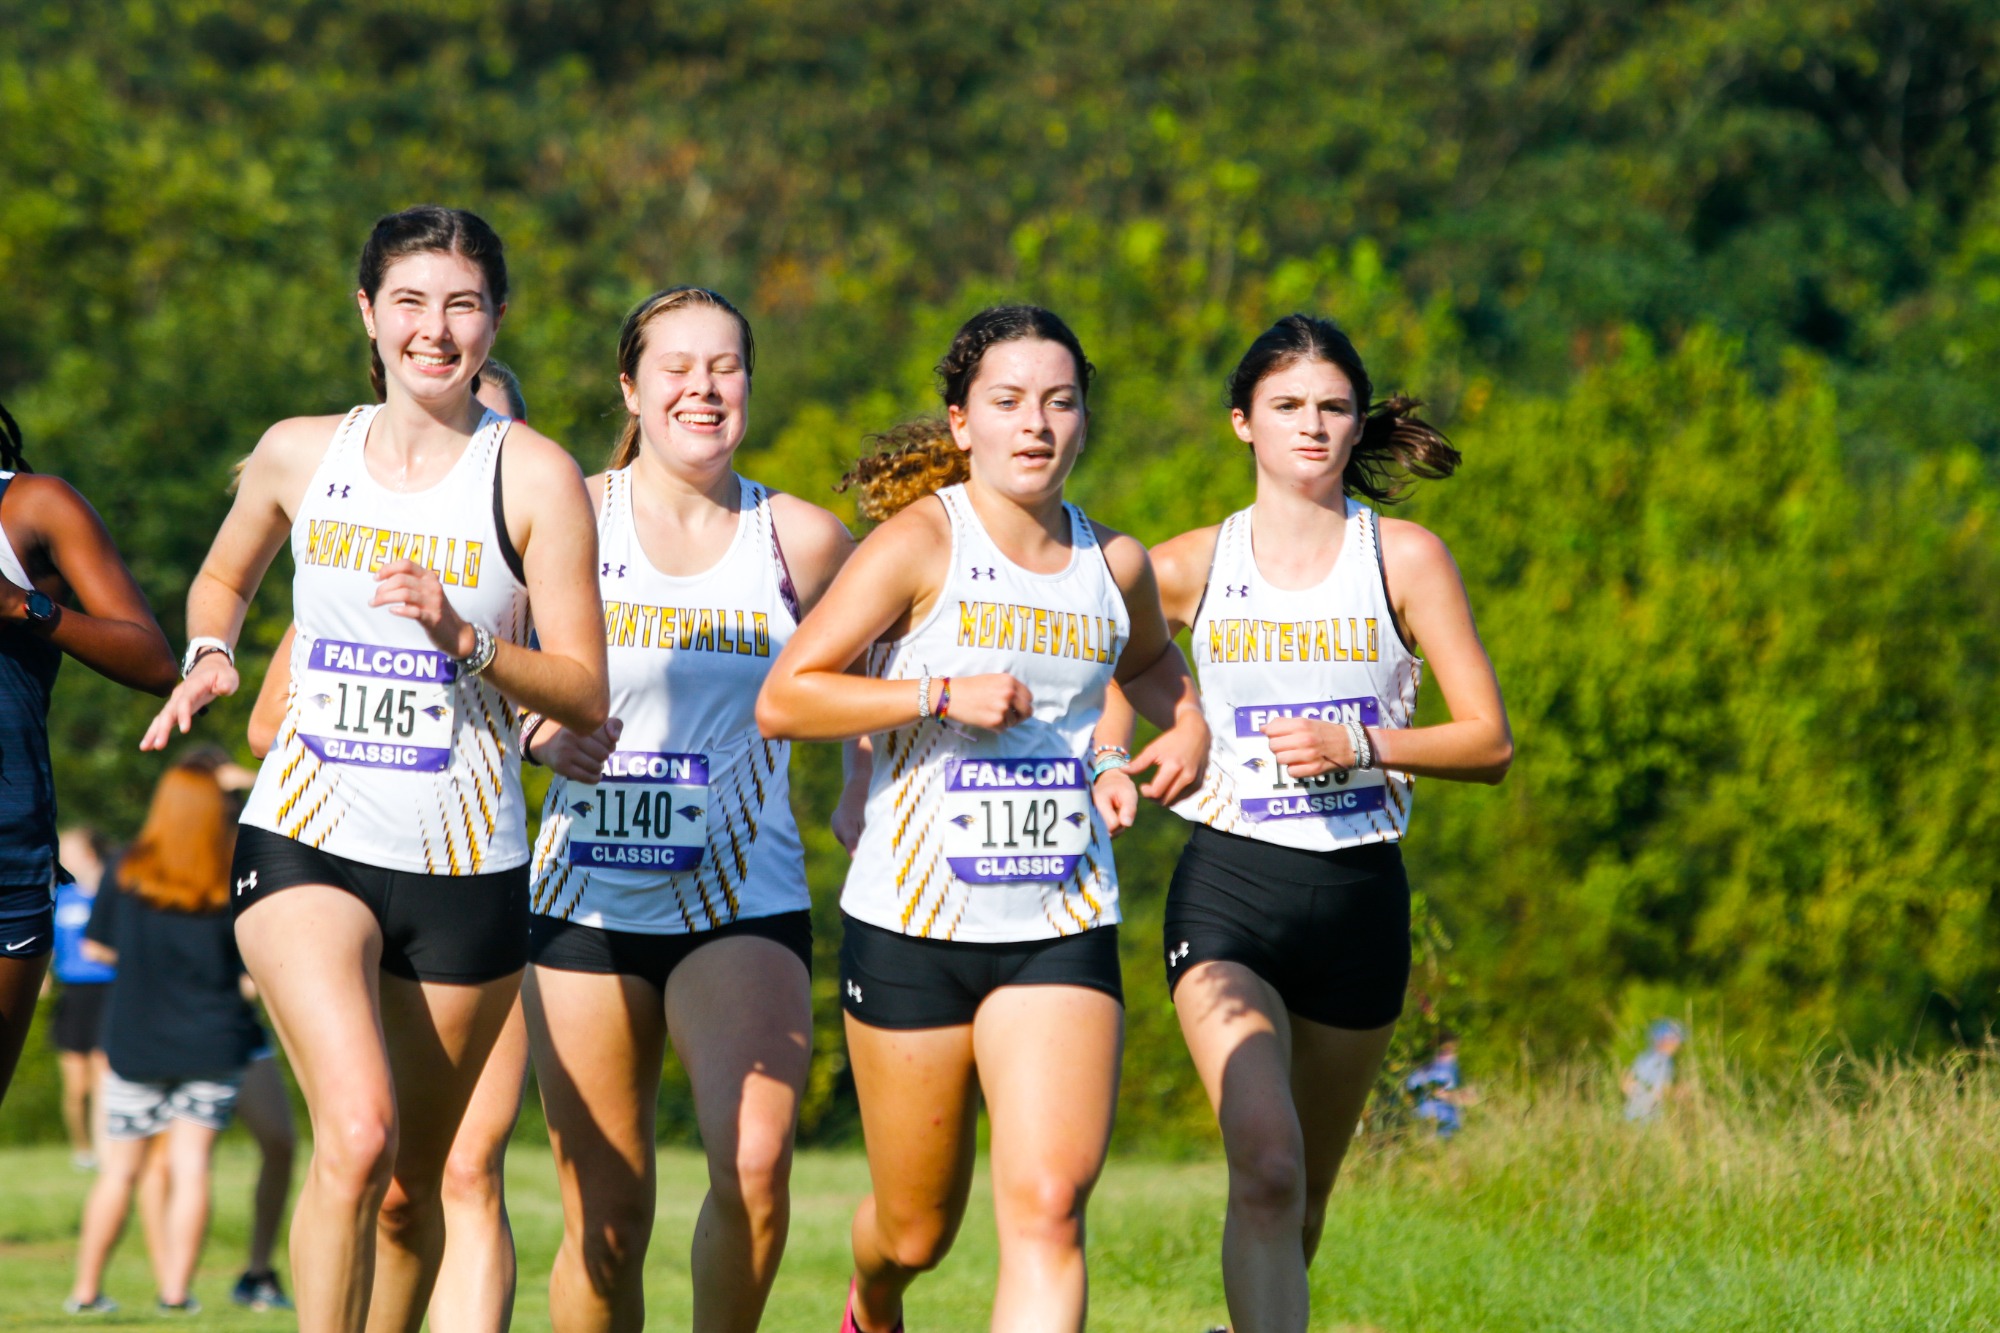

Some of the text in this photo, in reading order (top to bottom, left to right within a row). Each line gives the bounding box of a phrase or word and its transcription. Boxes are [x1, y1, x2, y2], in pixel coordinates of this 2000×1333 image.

[305, 519, 483, 588] MONTEVALLO
[601, 600, 770, 658] ONTEVALLO
[1209, 618, 1379, 663] MONTEVALLO
[324, 643, 438, 678] FALCON
[334, 682, 417, 738] 1145
[324, 740, 418, 766] CLASSIC
[601, 755, 691, 780] ALCON
[961, 762, 1076, 787] FALCON
[595, 789, 672, 840] 1140
[1267, 792, 1358, 816] CLASSIC
[981, 798, 1058, 848] 1142
[591, 844, 675, 865] CLASSIC
[975, 856, 1065, 877] CLASSIC
